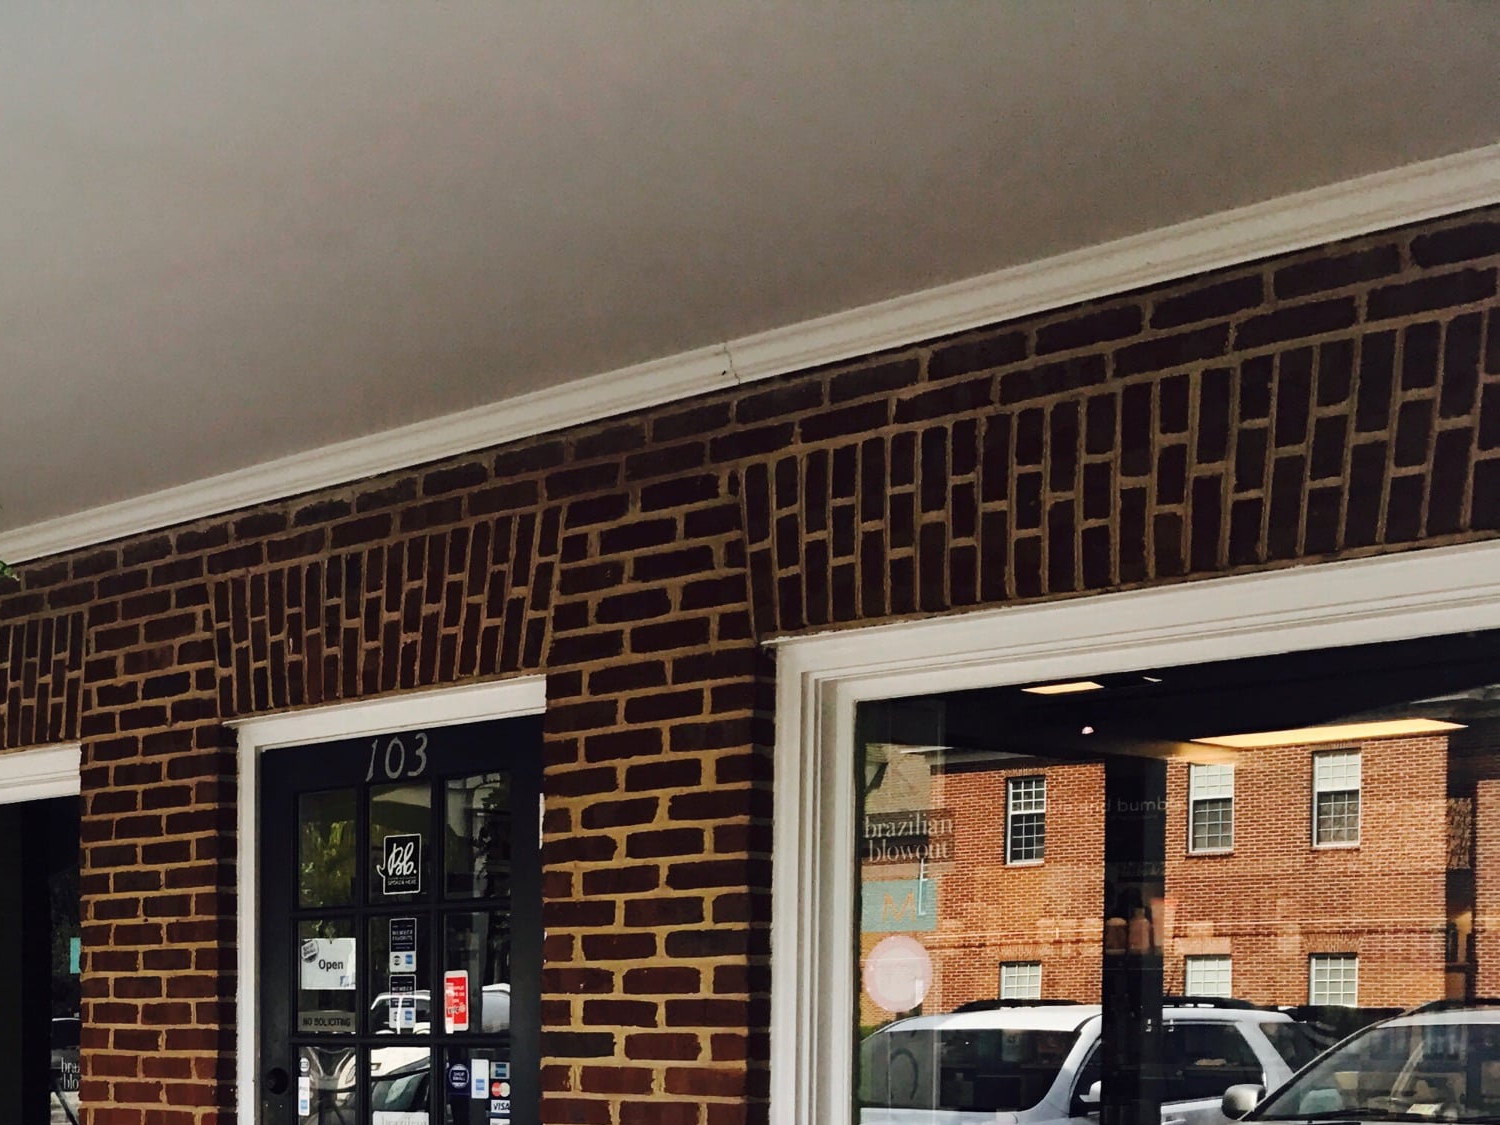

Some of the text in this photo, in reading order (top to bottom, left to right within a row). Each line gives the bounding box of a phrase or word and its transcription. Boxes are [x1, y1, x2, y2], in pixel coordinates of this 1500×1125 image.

[365, 732, 428, 782] 103
[864, 813, 953, 839] brazilian
[868, 839, 950, 863] blowout
[318, 959, 344, 972] Open
[303, 1018, 312, 1026] NO
[493, 1103, 510, 1111] VISA
